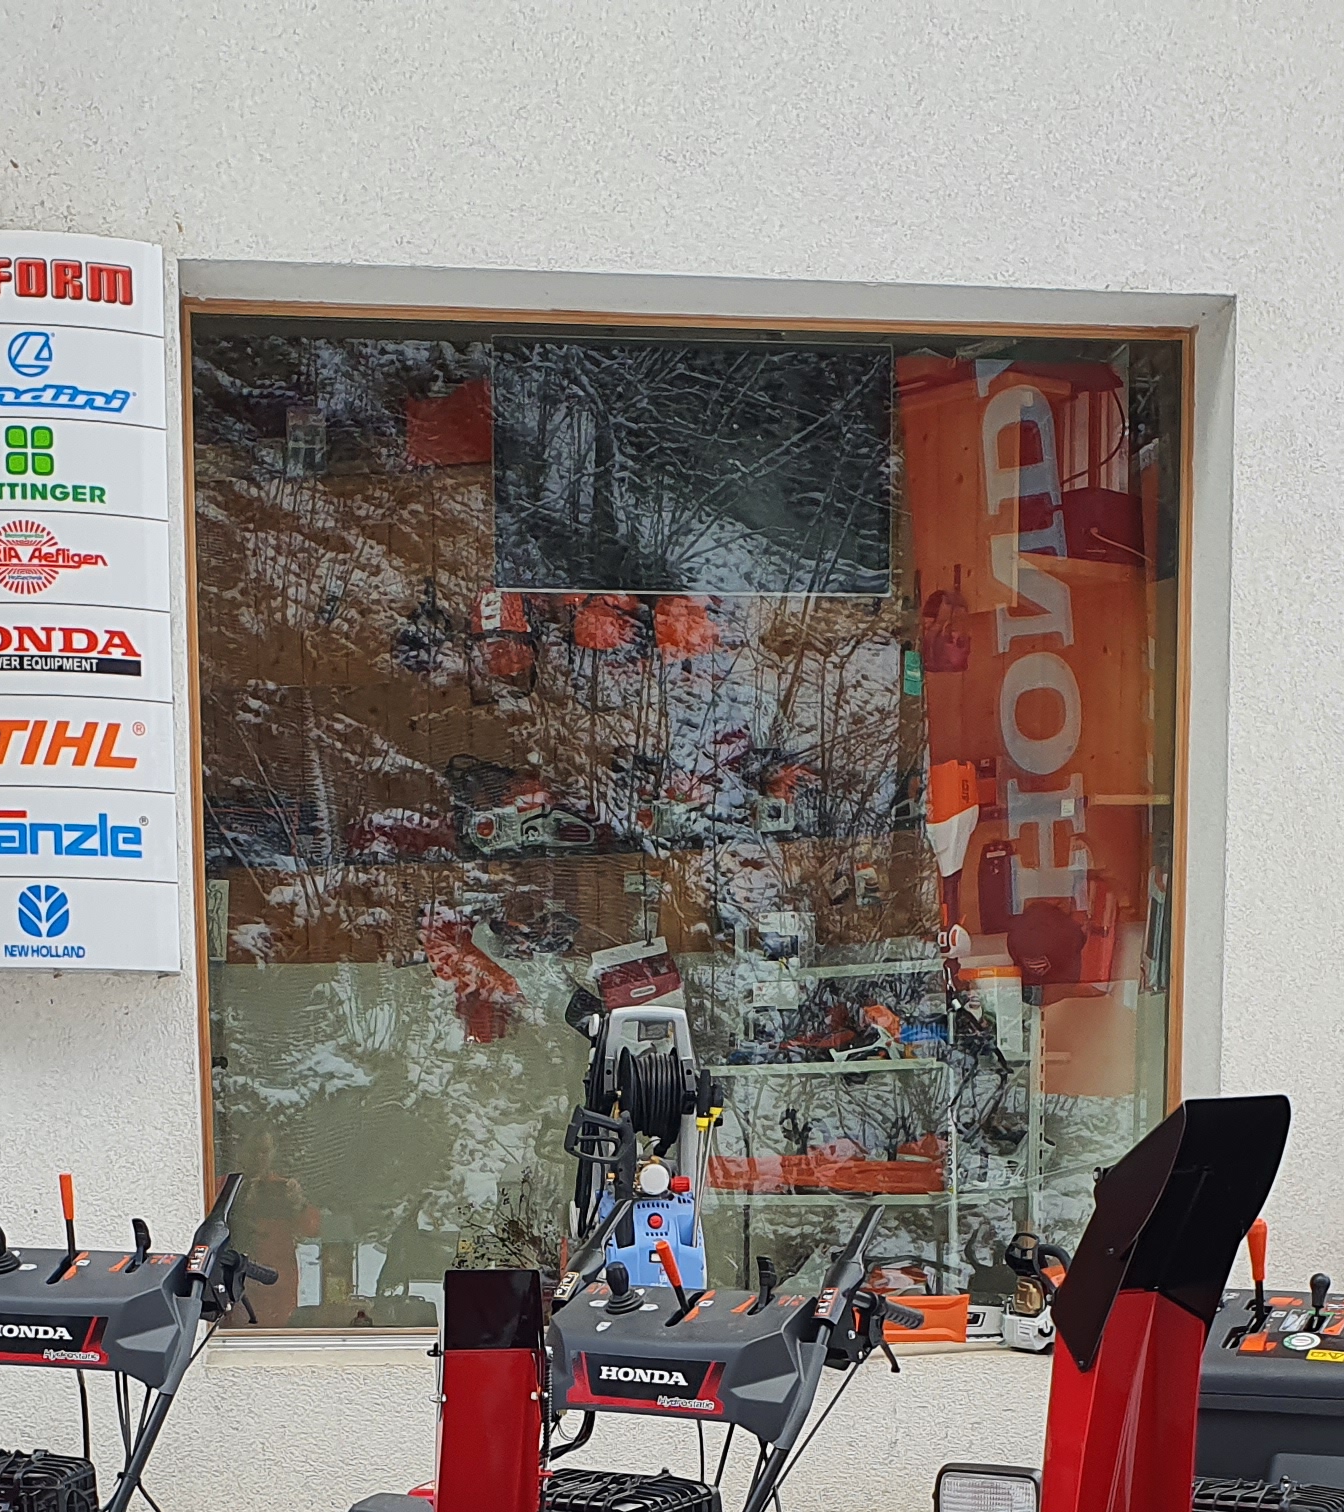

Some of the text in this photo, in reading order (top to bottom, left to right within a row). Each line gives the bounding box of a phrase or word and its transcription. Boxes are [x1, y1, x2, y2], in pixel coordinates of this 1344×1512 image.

[28, 547, 108, 569] Aefligen
[976, 359, 1089, 914] HOND
[24, 657, 99, 672] EQUIPMENT
[4, 944, 86, 959] NEW HOLLAND
[599, 1366, 689, 1386] HONDA
[657, 1395, 715, 1410] Hydrostatic
